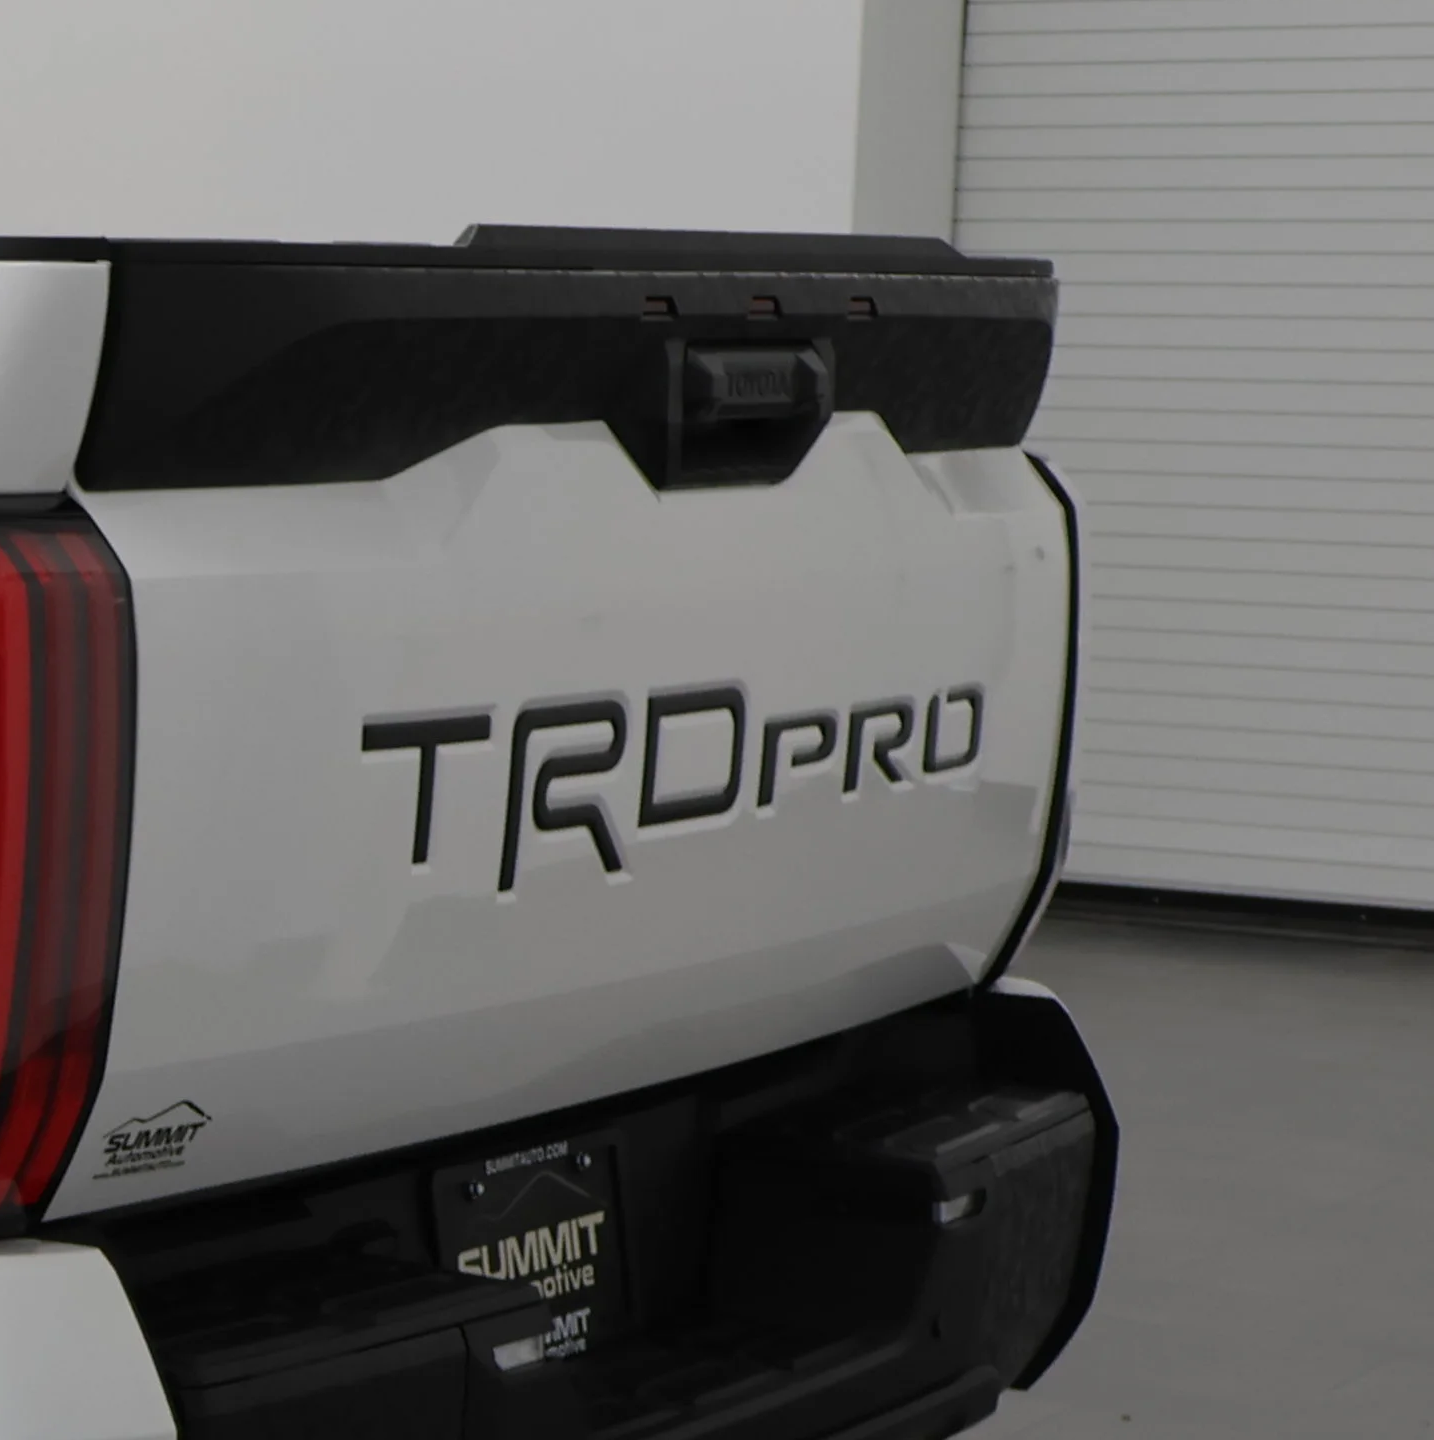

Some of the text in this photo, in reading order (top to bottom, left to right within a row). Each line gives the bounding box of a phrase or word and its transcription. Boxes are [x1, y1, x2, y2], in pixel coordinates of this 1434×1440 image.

[360, 685, 984, 893] TRD PRO
[104, 1121, 206, 1154] SUMMIT
[458, 1210, 605, 1281] SUMMIT
